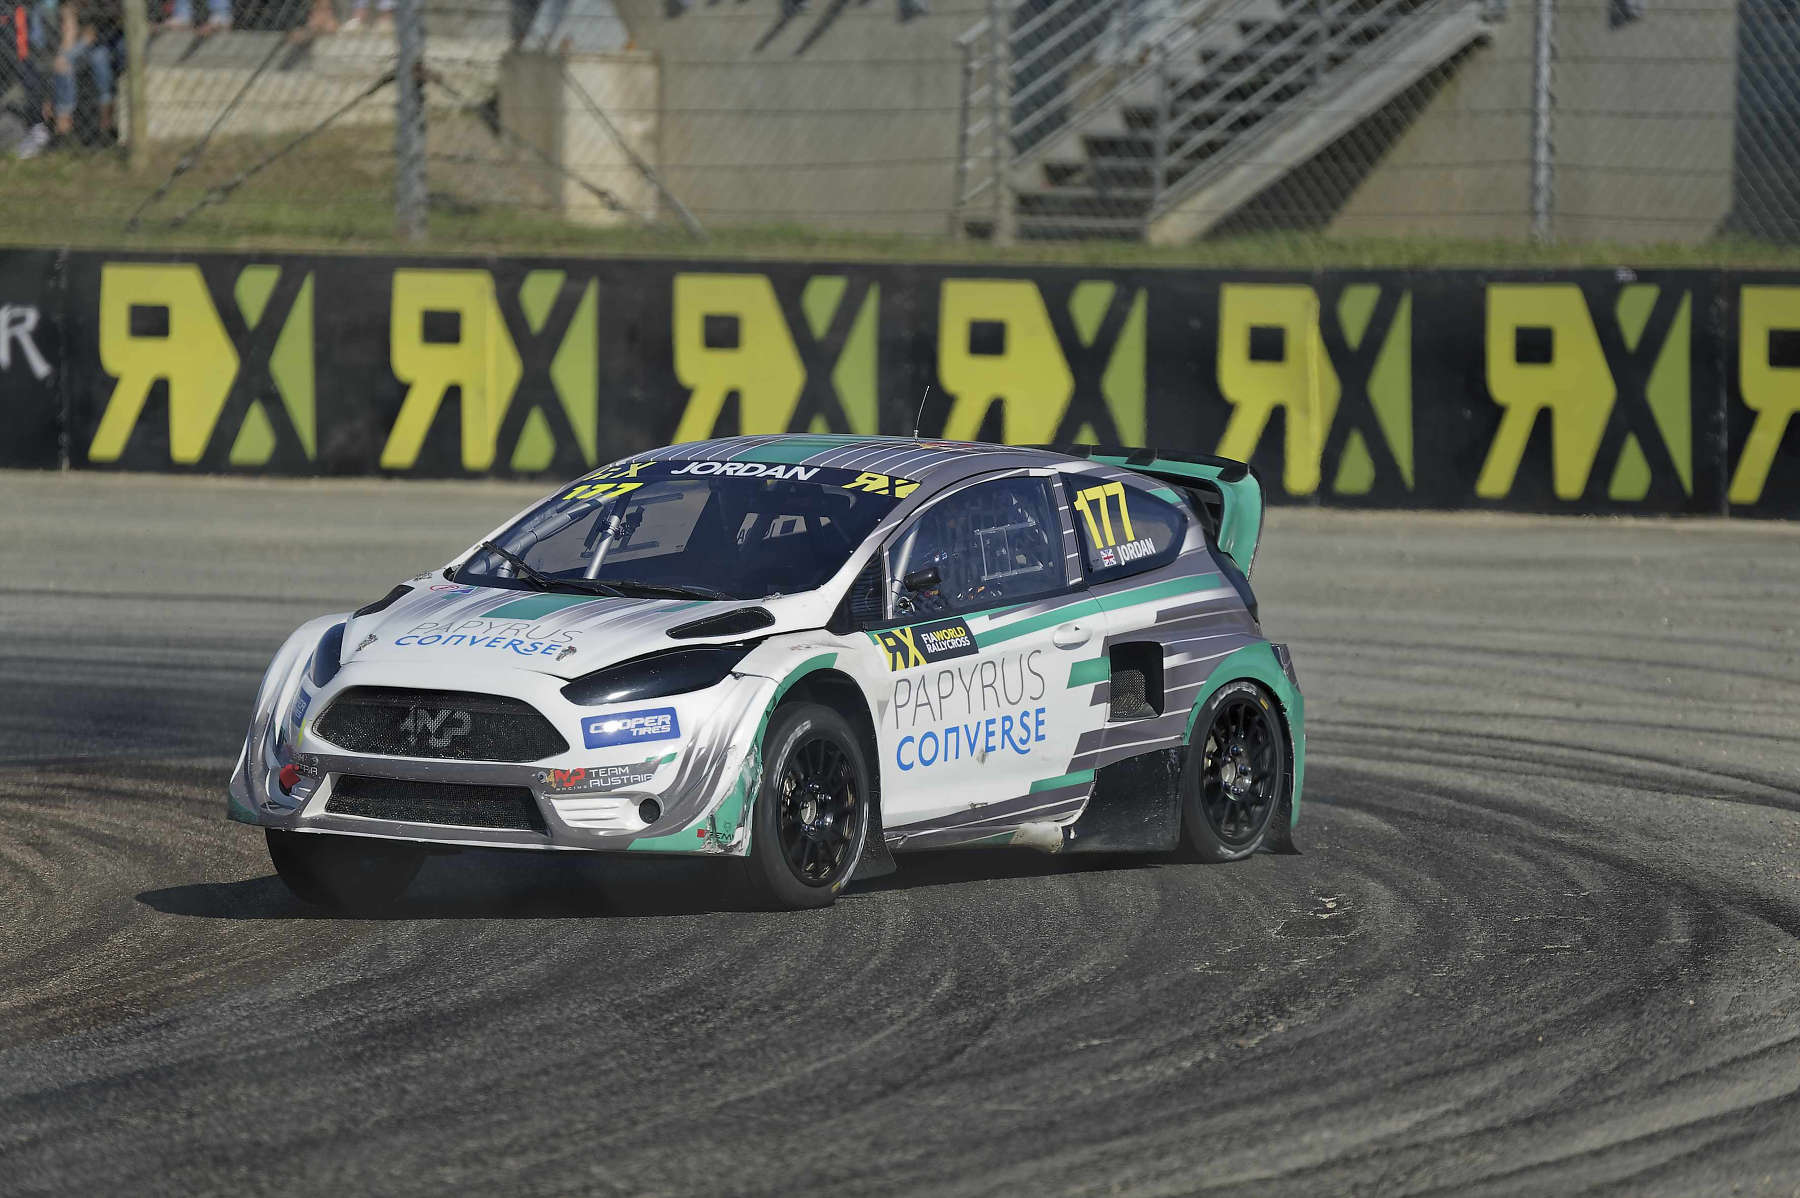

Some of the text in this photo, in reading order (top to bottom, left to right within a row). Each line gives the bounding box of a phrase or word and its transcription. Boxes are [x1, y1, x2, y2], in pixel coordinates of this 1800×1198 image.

[671, 462, 820, 481] JORDAN
[562, 482, 645, 500] 177
[1073, 481, 1135, 549] 177
[1117, 538, 1156, 565] JORDAN
[406, 620, 583, 643] PAPYRUS
[926, 636, 970, 653] RALLYCROSS
[894, 650, 1045, 729] PAPYRUS
[630, 725, 672, 736] TIRES
[589, 766, 629, 777] TEAM
